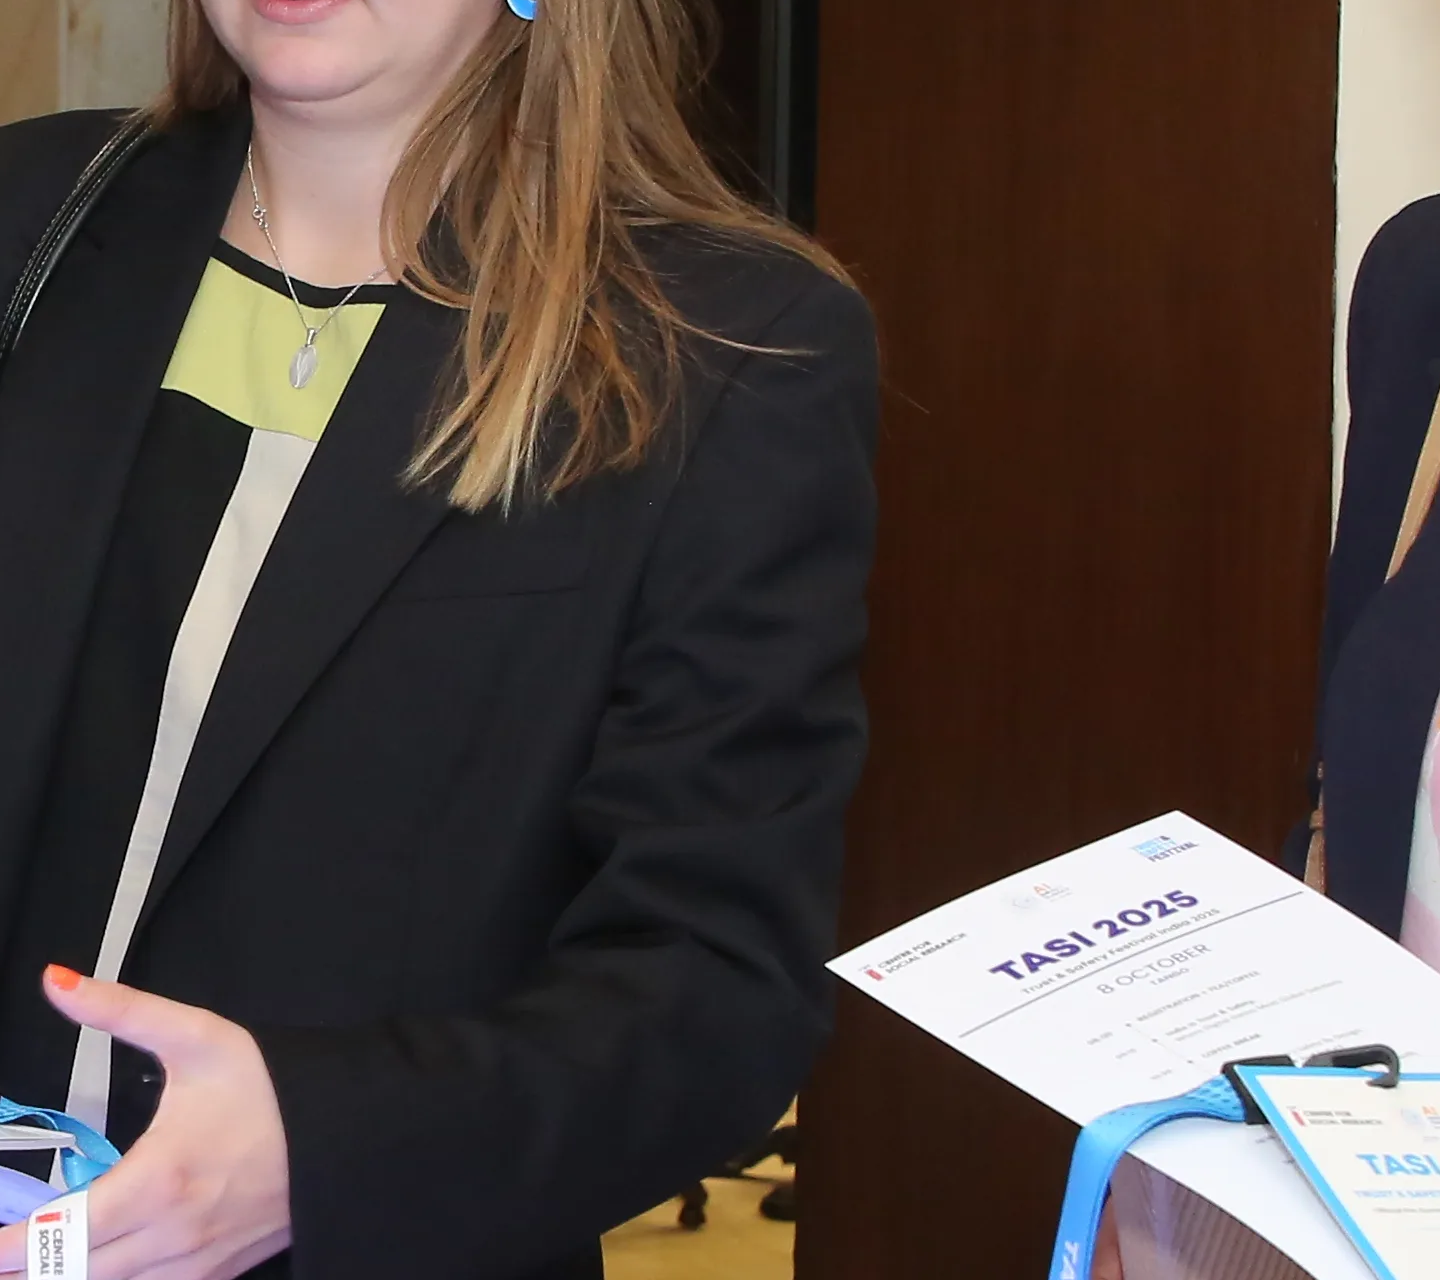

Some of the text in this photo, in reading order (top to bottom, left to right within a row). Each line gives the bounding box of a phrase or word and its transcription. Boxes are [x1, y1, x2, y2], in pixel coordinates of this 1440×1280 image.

[1148, 842, 1200, 862] FESTIVAL
[989, 889, 1199, 981] TASI 2025
[1021, 974, 1056, 995] Trust
[1066, 953, 1109, 975] Safety
[1108, 932, 1158, 956] Festival
[1190, 908, 1221, 923] 2025
[1096, 943, 1212, 995] 8 OCTOBER
[39, 1228, 50, 1276] SOCIAL
[53, 1228, 64, 1276] CENTRE
